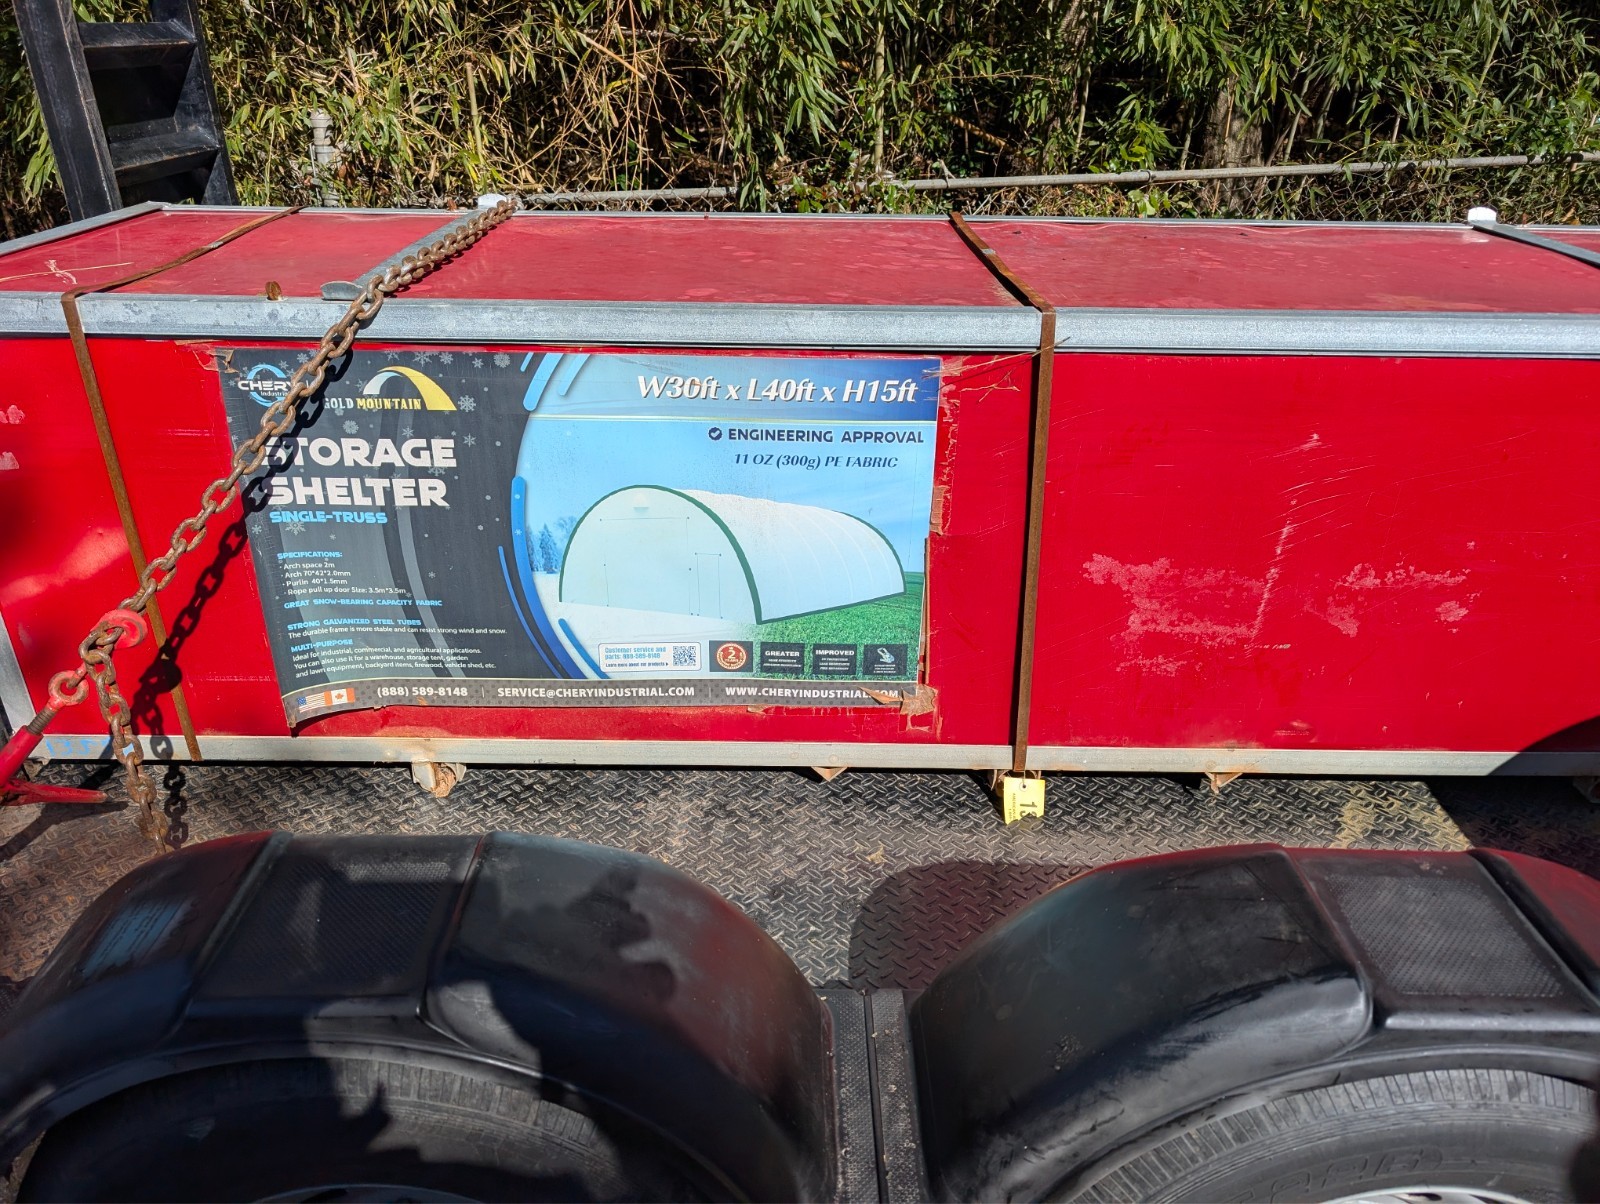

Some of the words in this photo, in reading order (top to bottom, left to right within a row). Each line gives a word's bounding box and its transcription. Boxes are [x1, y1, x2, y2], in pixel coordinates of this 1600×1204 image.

[637, 375, 721, 400] W30ft
[724, 383, 740, 400] x
[746, 378, 816, 402] L40ft
[820, 386, 837, 402] x
[842, 378, 919, 402] H15ft
[355, 398, 421, 410] MOUNTAIN
[728, 428, 833, 443] ENGINEERING
[841, 431, 924, 443] APPROVAL
[261, 437, 457, 467] STORAGE
[735, 453, 749, 465] 11
[753, 454, 774, 465] OZ
[776, 454, 821, 471] (300g)
[824, 456, 843, 467] PE
[845, 456, 898, 468] FABRIC
[268, 476, 450, 507] SHELTER
[269, 510, 388, 524] SINGLE-TRUSS
[277, 551, 343, 560] SPECIFICATIONS:
[283, 562, 301, 570] Arch
[286, 579, 309, 587] Purlin
[287, 588, 307, 596] Rope
[284, 600, 309, 609] GREAT
[287, 620, 320, 631] STRONG
[288, 632, 301, 640] The
[302, 628, 329, 637] durable
[329, 626, 348, 634] frame
[290, 638, 354, 653] MULTI-PURPOSE
[292, 653, 309, 662] Ideal
[320, 647, 354, 657] industrial,
[442, 647, 482, 655] applications.
[727, 650, 736, 659] 2
[326, 663, 365, 673] equipment,
[377, 687, 410, 698] (888)
[412, 687, 469, 697] 589-8148
[497, 687, 695, 699] SERVICE@CHERYINDUSTRIAL.COM
[725, 687, 899, 698] WWW.CHERYINDUSTRIAL.OM
